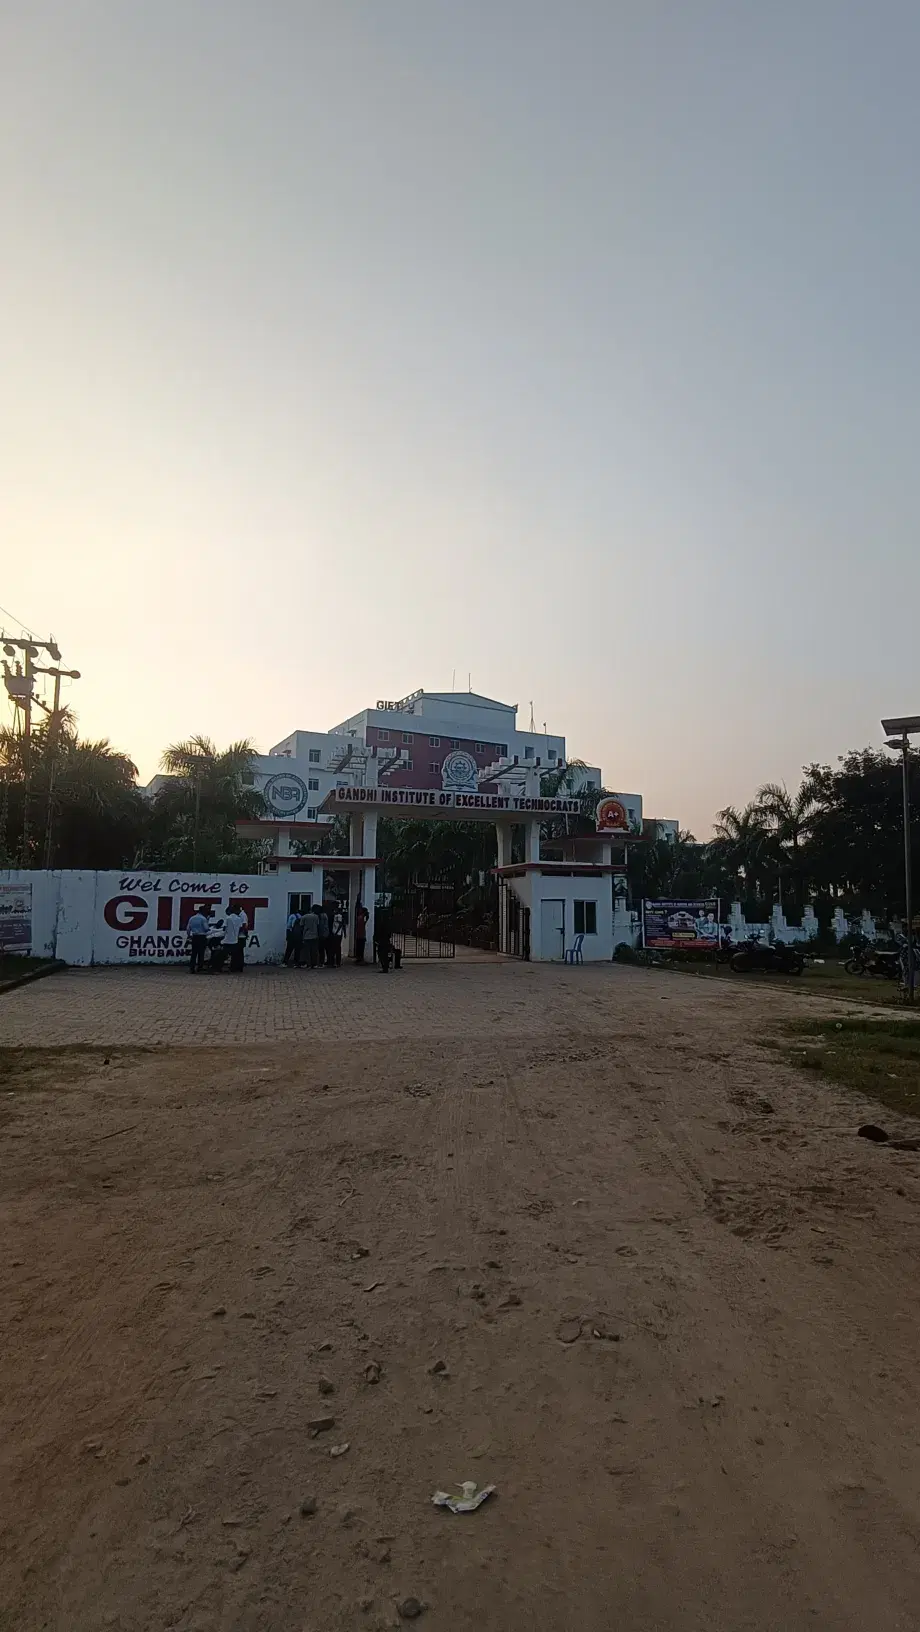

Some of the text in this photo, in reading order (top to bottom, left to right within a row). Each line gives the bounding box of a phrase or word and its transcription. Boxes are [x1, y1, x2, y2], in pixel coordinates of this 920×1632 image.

[338, 787, 579, 812] GANDHI INSTITUTE OF EXCELLENT TECHNOCRATS
[119, 877, 249, 894] Wel Come to
